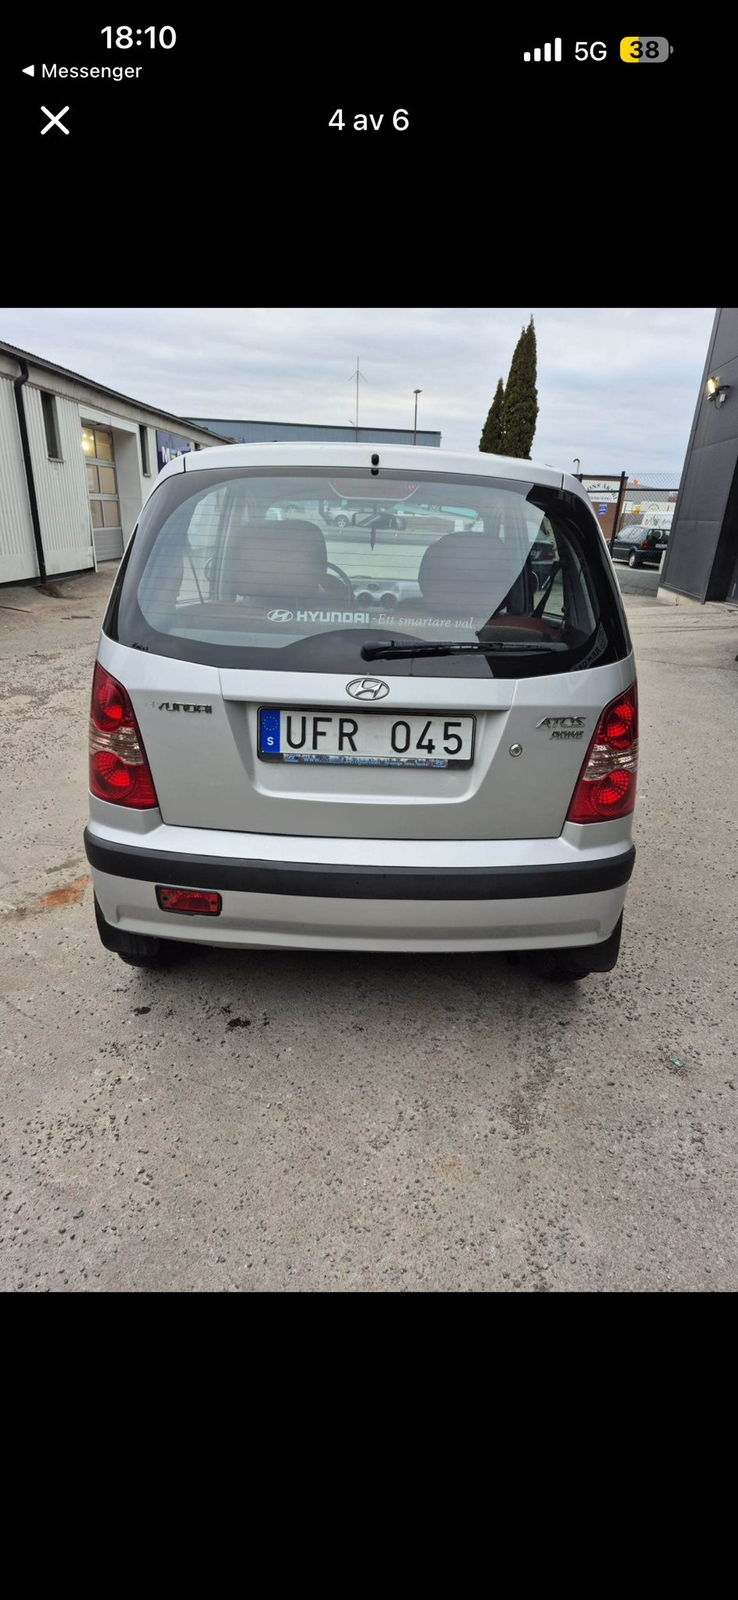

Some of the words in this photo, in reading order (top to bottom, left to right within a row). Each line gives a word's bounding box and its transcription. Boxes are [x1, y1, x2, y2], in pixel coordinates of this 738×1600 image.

[296, 610, 370, 624] HYUNDAI
[398, 616, 452, 628] smartare
[454, 617, 477, 630] val.
[535, 716, 587, 729] ATOS
[266, 736, 275, 746] S
[286, 716, 359, 752] UFR
[391, 720, 463, 755] 045
